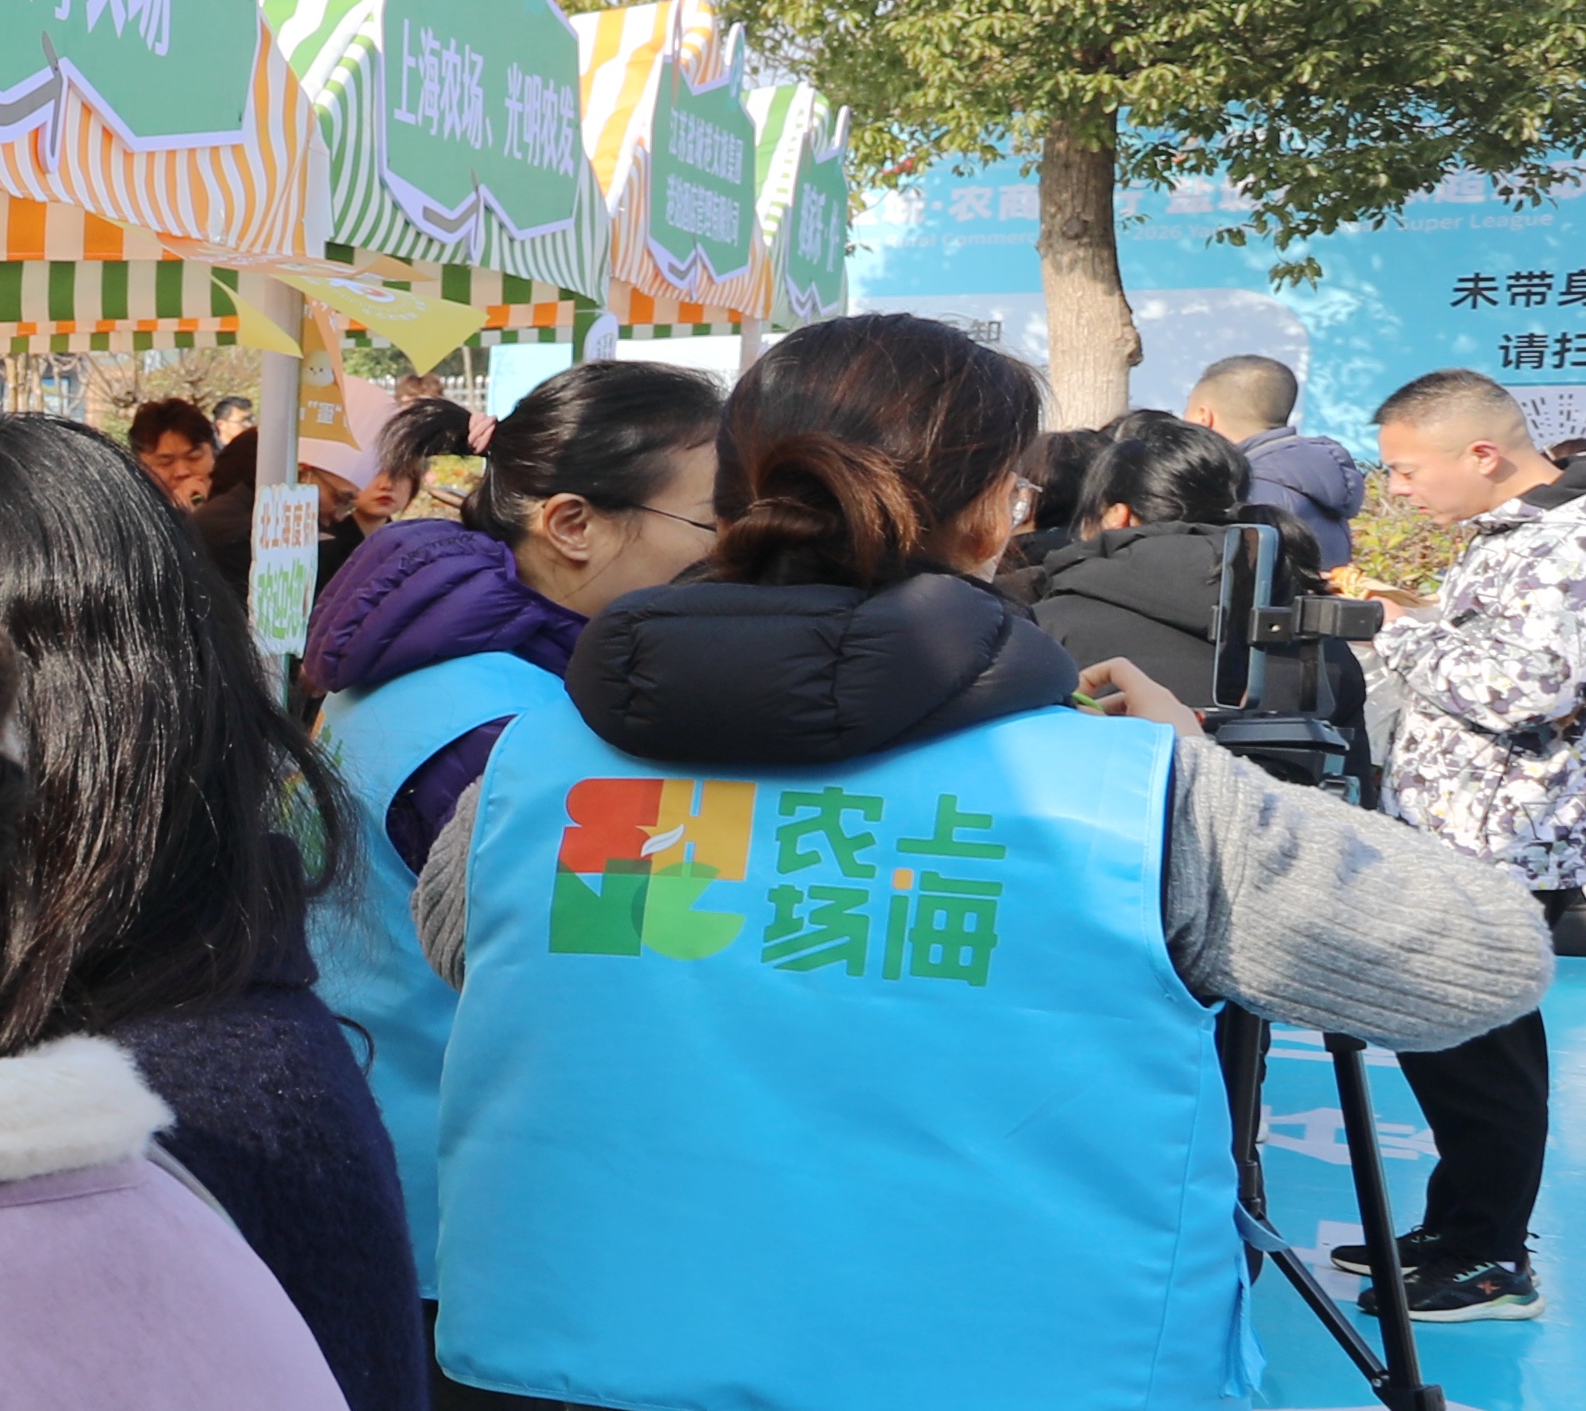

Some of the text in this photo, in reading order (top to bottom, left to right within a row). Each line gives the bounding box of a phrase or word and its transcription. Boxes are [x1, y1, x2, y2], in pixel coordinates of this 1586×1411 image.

[392, 15, 576, 180] 上海农场、光明农发
[1469, 212, 1555, 232] League
